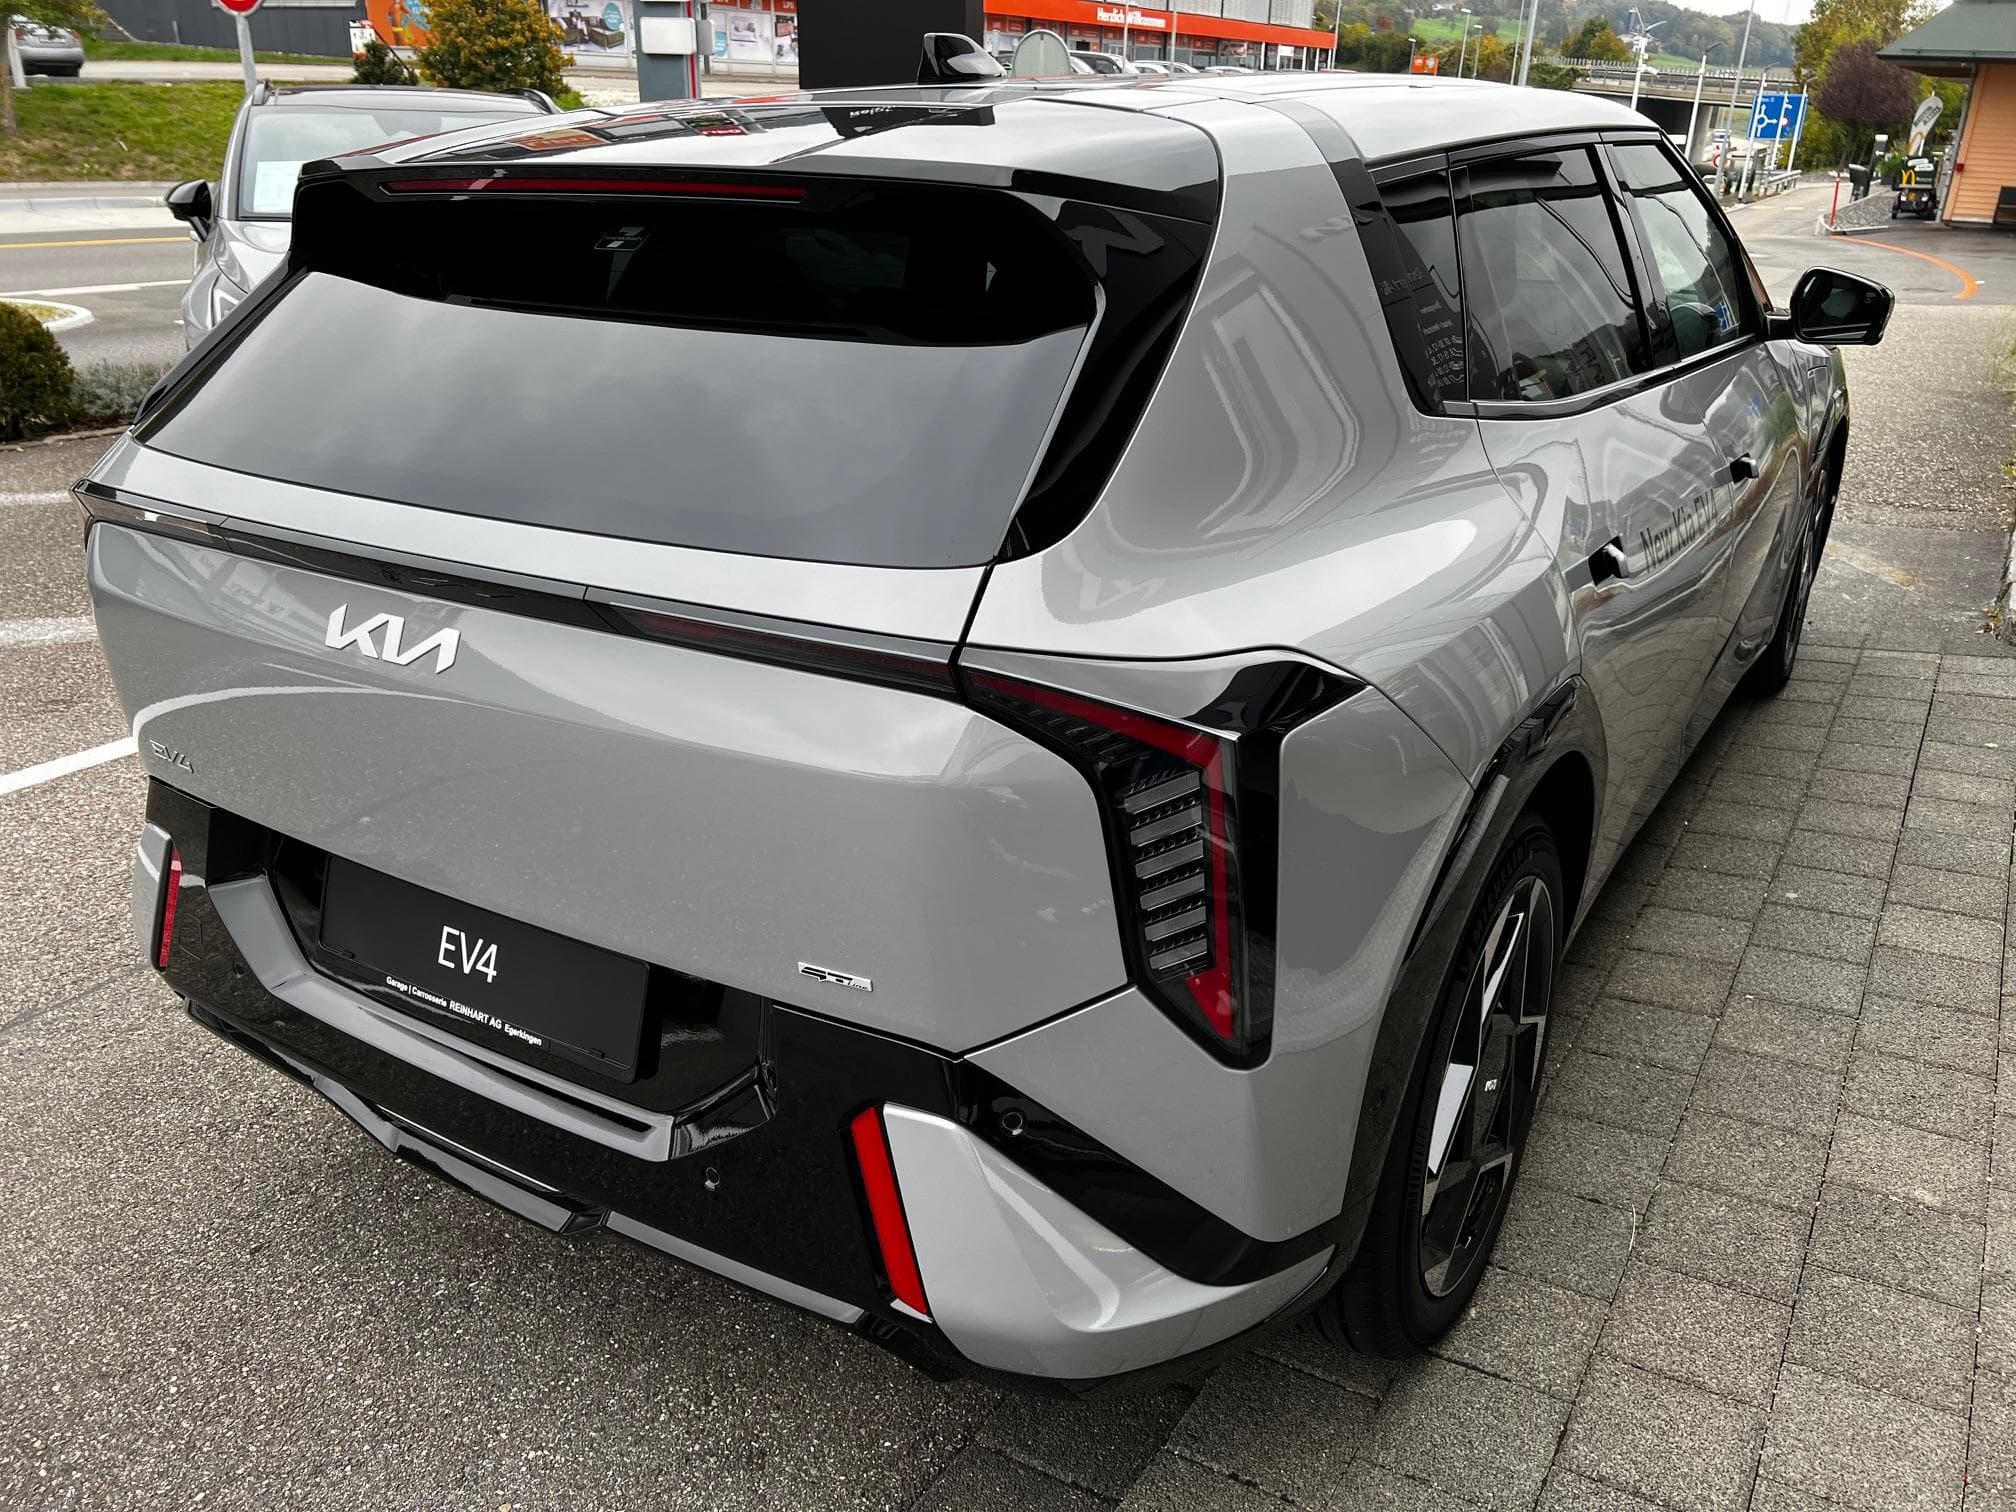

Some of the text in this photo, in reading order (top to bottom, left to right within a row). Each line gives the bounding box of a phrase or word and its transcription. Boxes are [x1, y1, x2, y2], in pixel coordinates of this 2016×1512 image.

[1640, 489, 1718, 573] New Kia EV4
[325, 603, 461, 675] KIA
[148, 739, 195, 775] EV4
[1472, 841, 1525, 942] MICHELIN
[437, 925, 499, 984] EV4
[386, 976, 408, 993] Garage
[411, 986, 448, 1007] Carrosserie
[449, 1000, 490, 1025] REINHART
[489, 1017, 503, 1030] AG
[504, 1023, 543, 1046] Egerkingen
